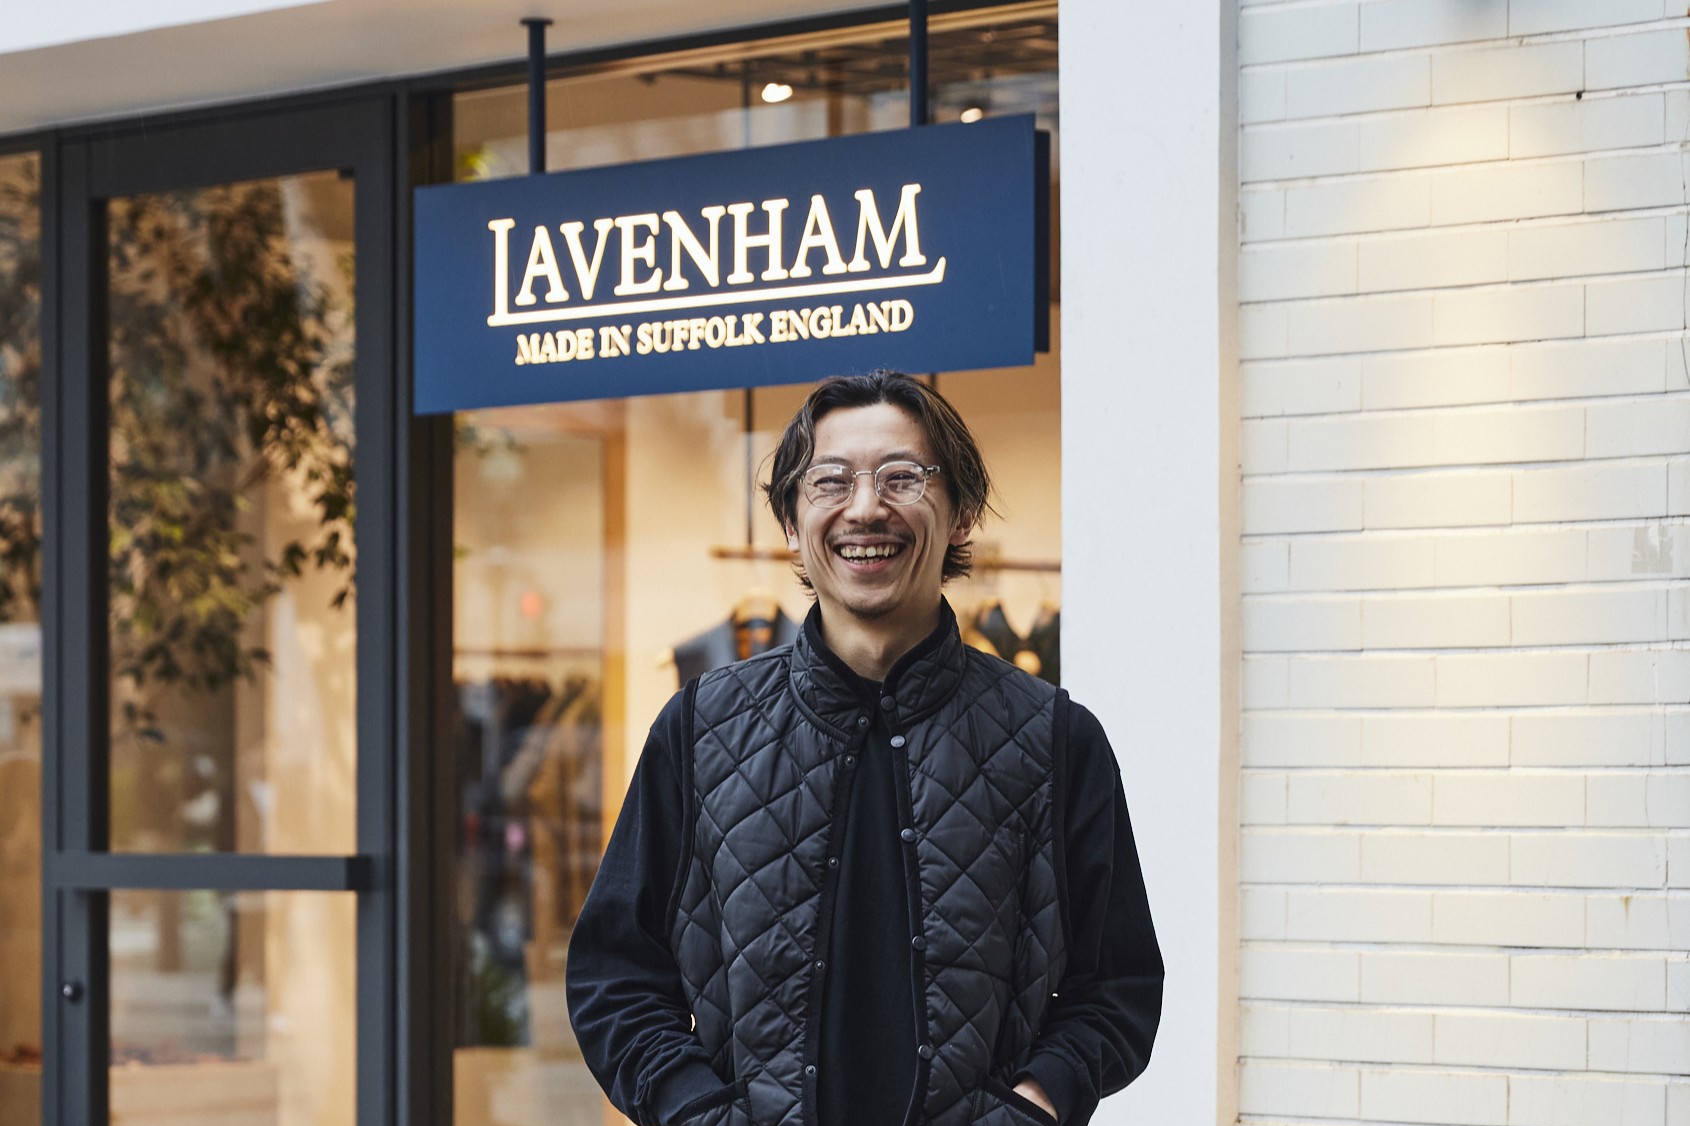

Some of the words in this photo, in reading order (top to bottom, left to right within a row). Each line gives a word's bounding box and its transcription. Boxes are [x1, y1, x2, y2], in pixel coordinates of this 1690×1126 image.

[487, 183, 947, 328] LAVENHAM
[514, 327, 596, 366] MADE
[598, 324, 633, 359] IN
[636, 312, 766, 355] SUFFOLK
[769, 299, 915, 343] ENGLAND
